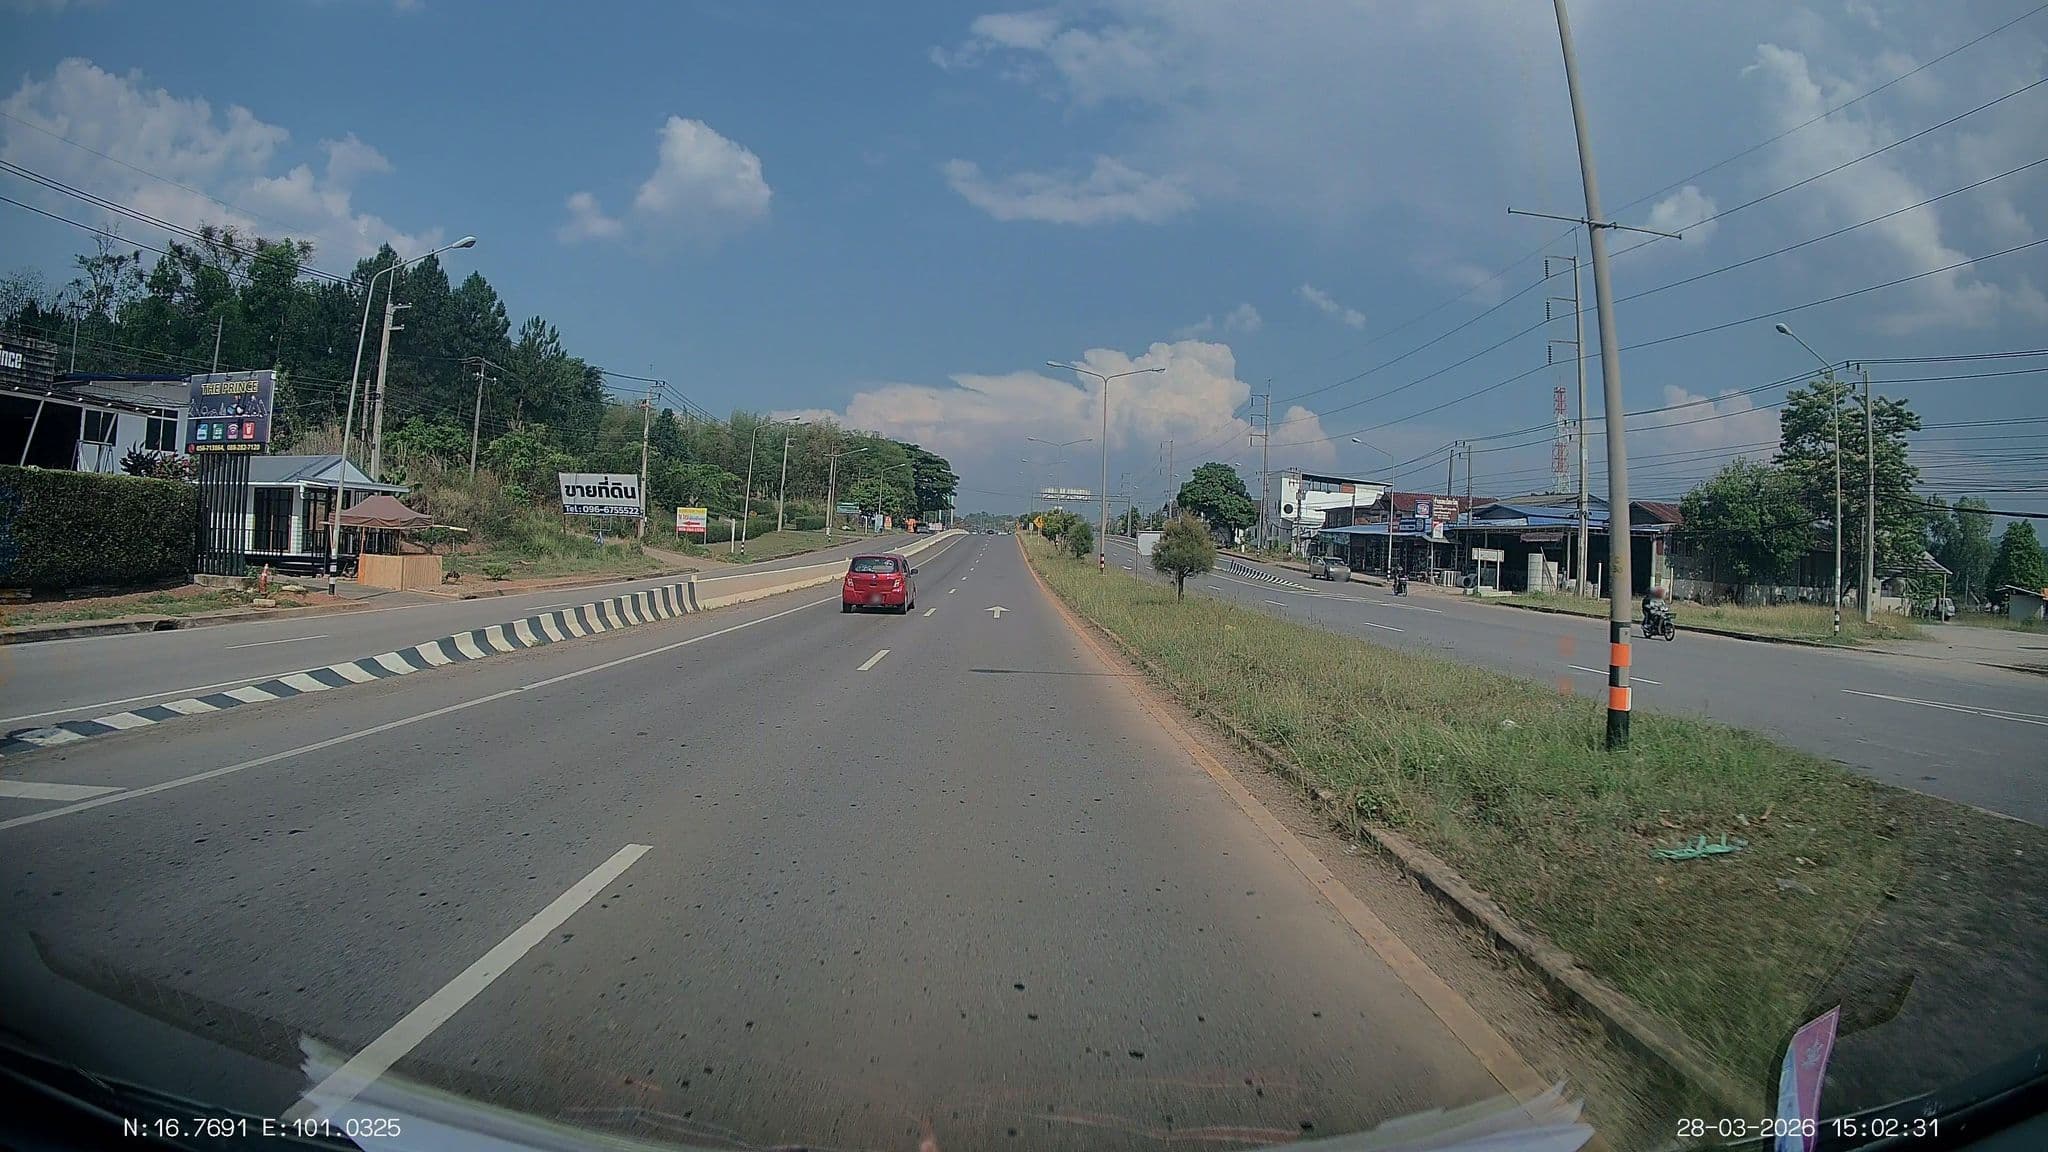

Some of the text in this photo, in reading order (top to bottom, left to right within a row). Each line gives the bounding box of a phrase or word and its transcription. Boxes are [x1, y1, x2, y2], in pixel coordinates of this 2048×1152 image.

[201, 380, 259, 395] THE PRINCE
[564, 476, 637, 499] ขายที่ดิน
[582, 505, 639, 515] 096-6755522
